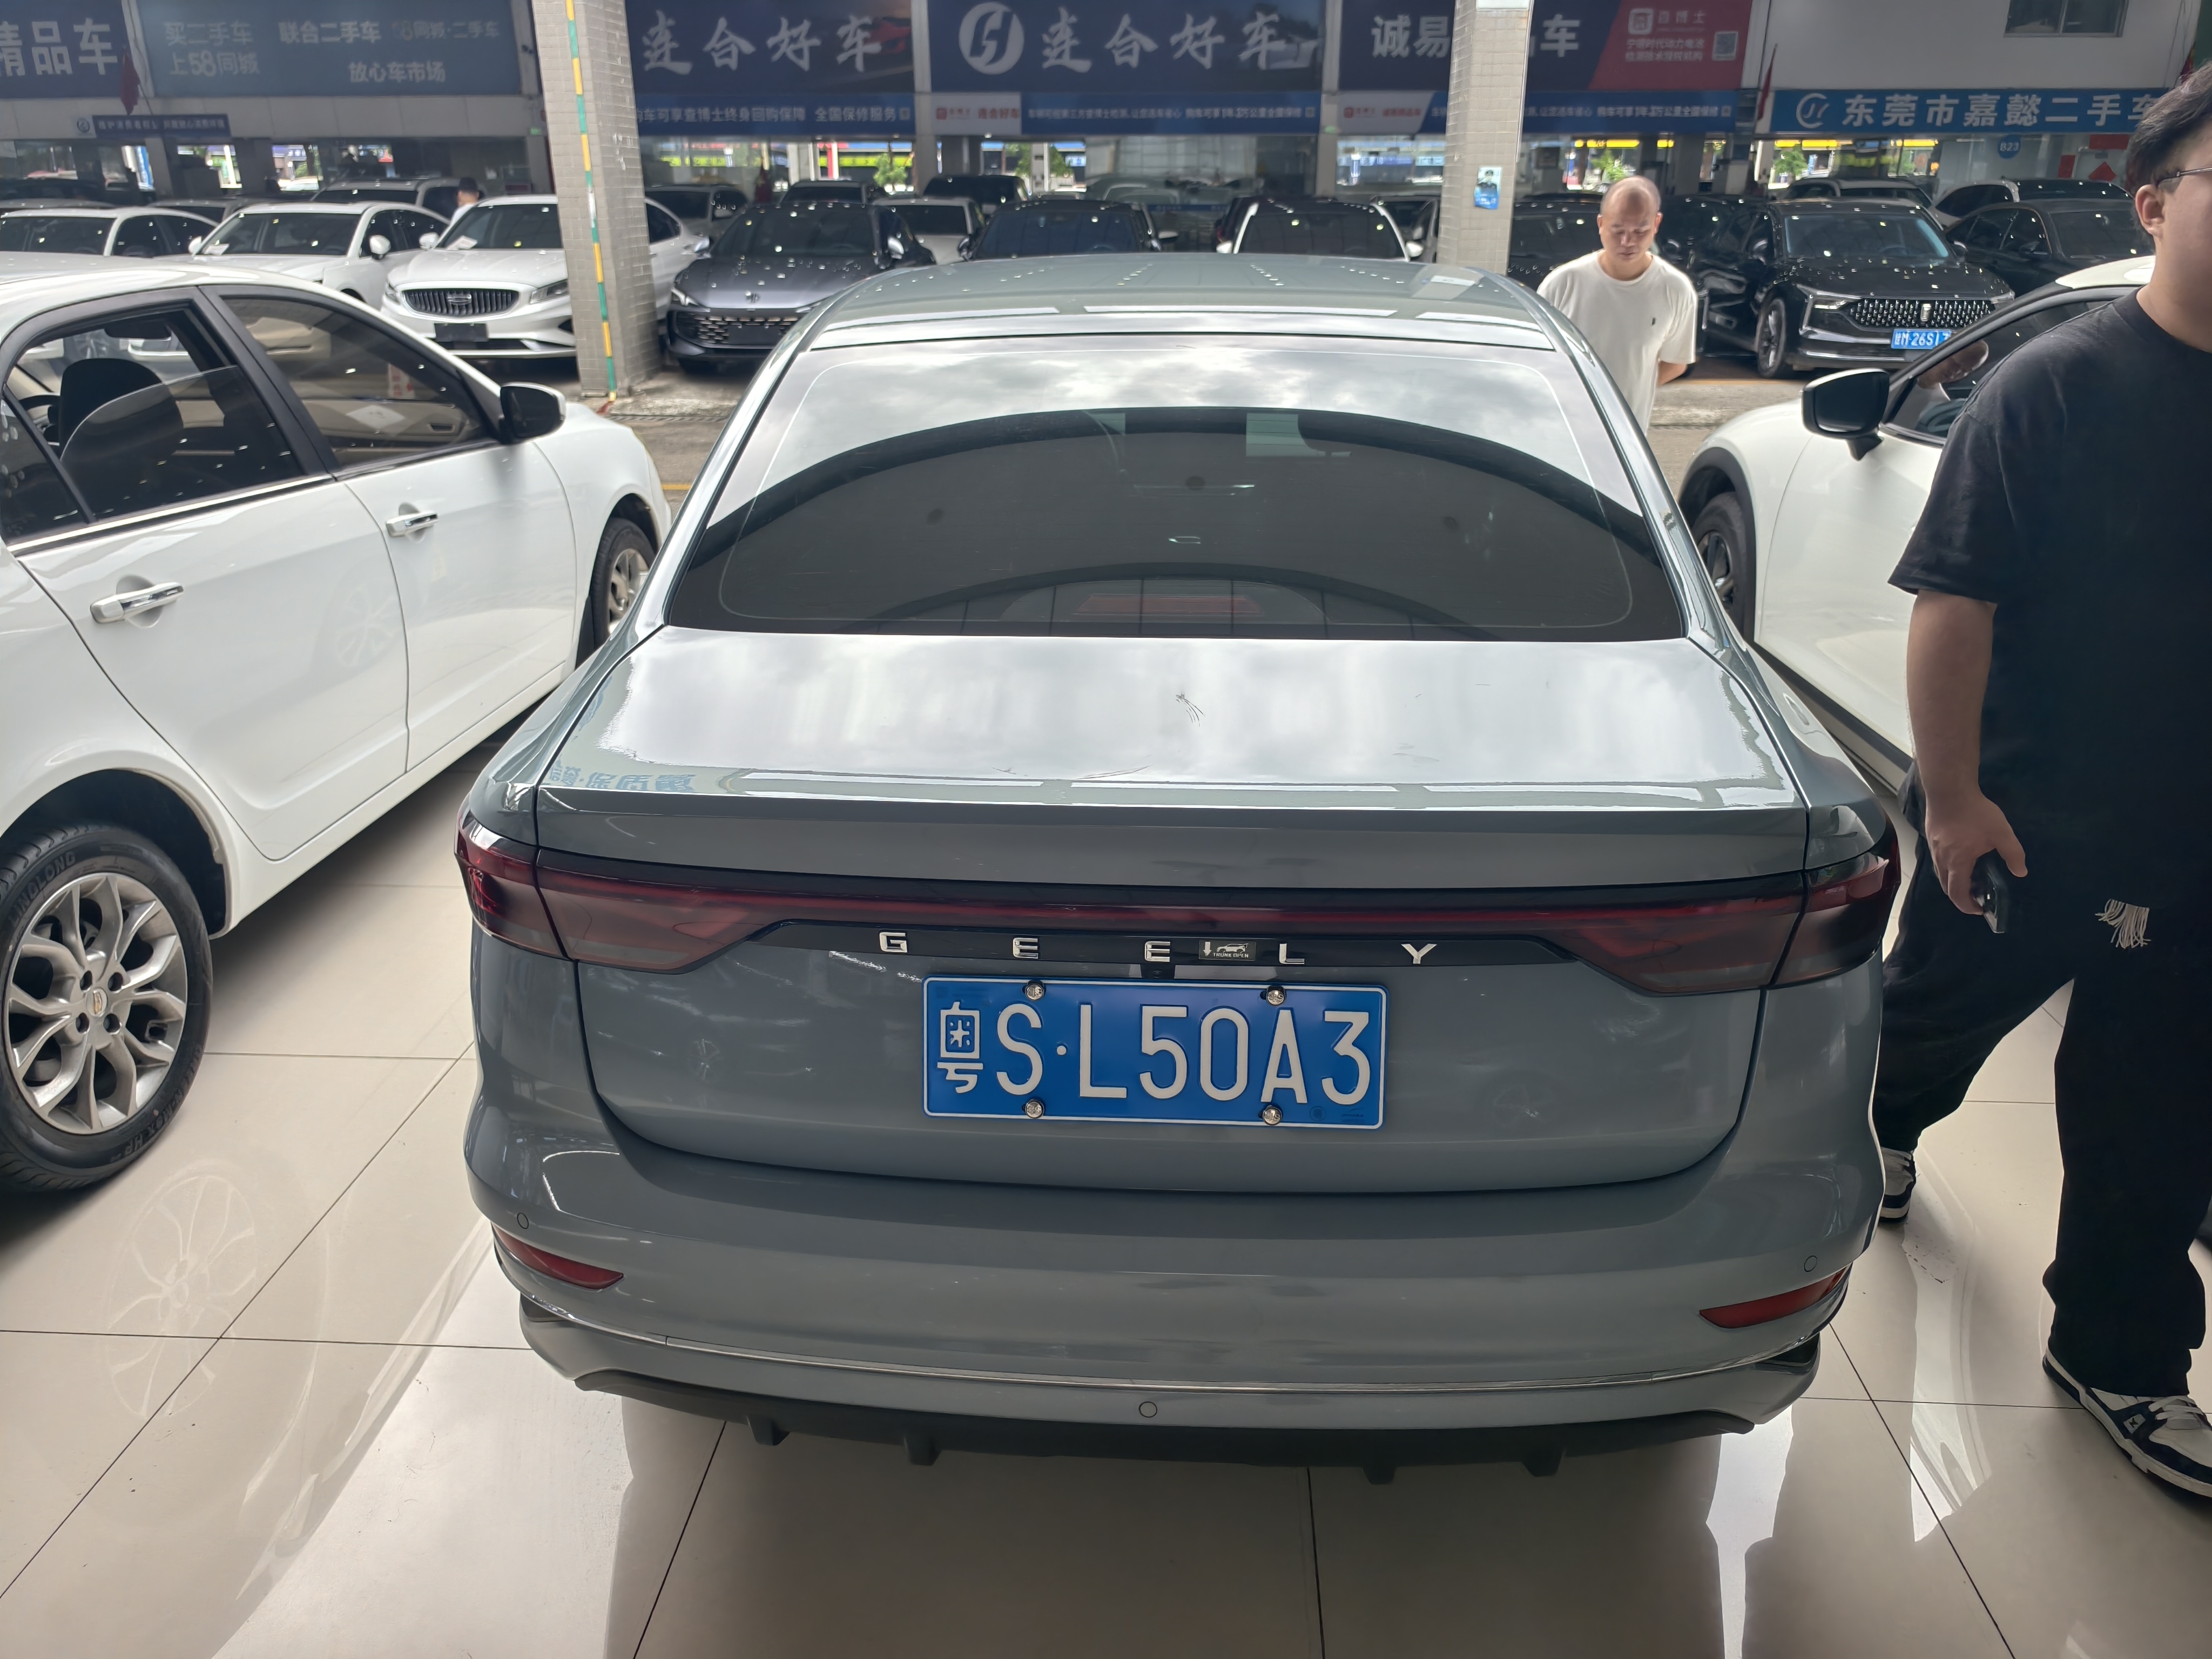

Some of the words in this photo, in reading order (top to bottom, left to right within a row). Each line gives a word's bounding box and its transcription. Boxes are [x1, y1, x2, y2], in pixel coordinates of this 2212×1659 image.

[165, 20, 254, 45] 买二手车
[278, 21, 381, 43] 联合二手车
[170, 50, 260, 76] 上58同城
[349, 61, 447, 83] 放心车市场
[879, 931, 1438, 965] GEELY
[936, 1001, 1371, 1104] 粤S·L50A3
